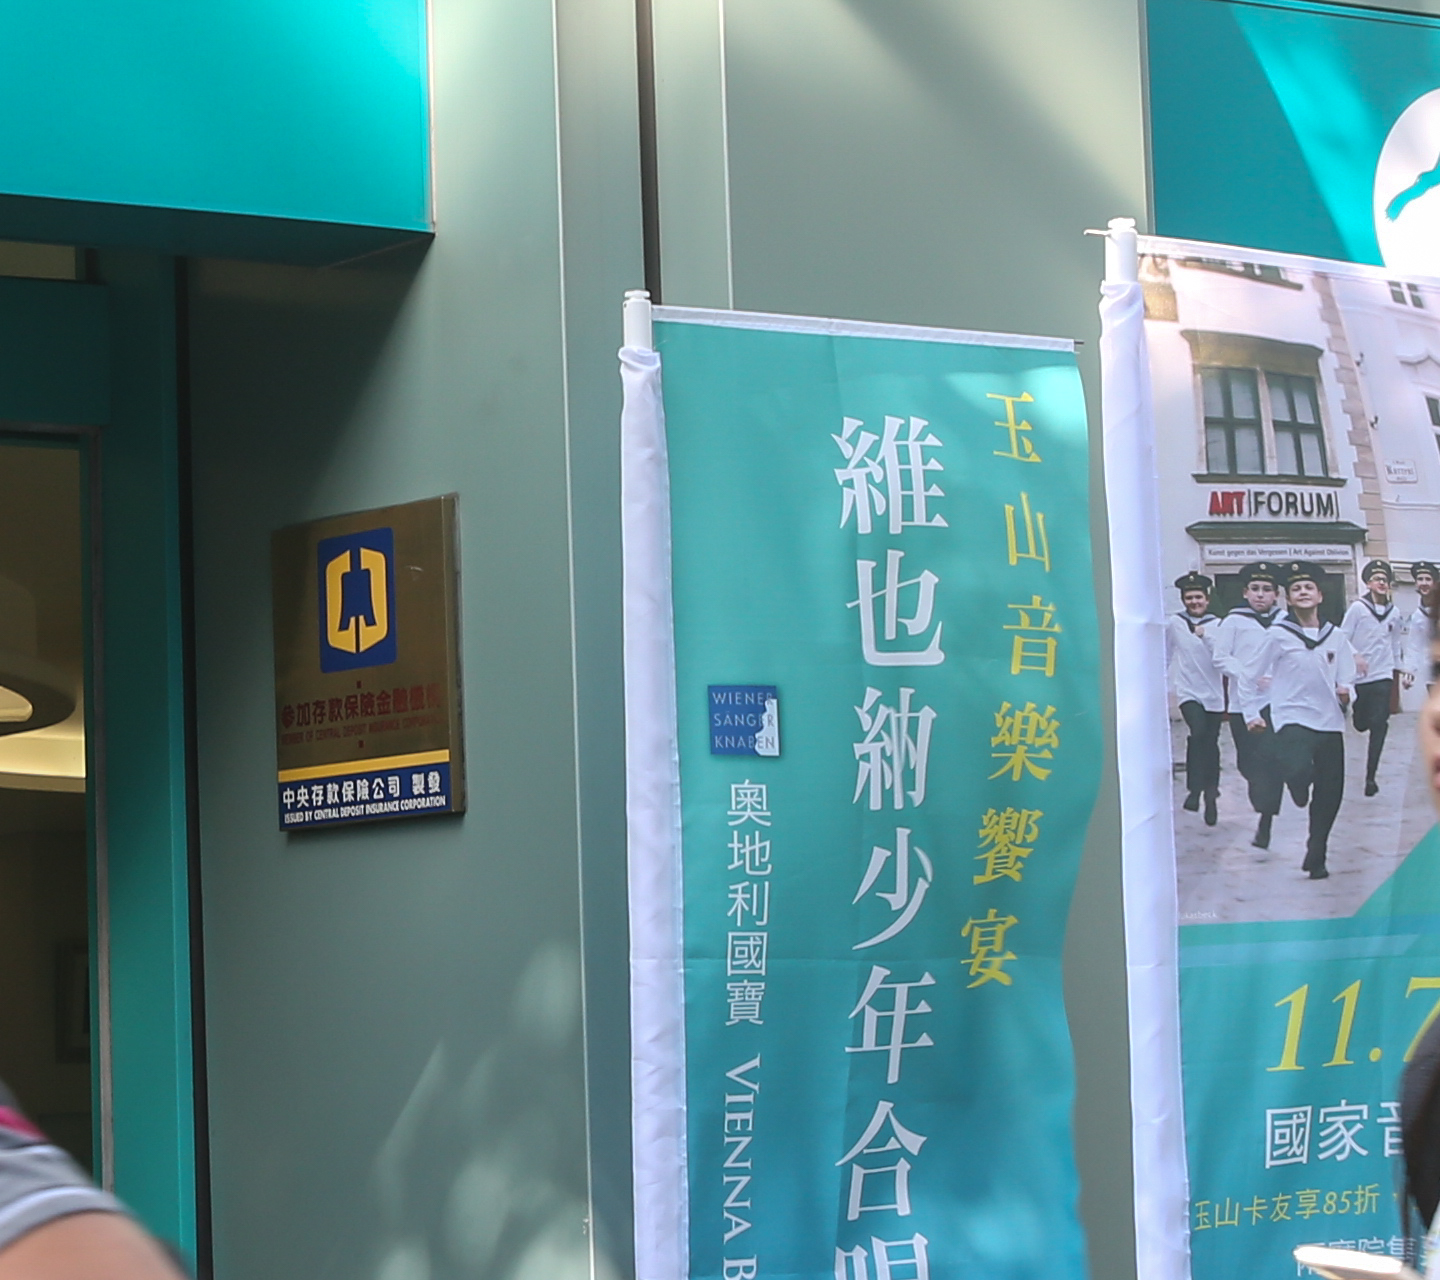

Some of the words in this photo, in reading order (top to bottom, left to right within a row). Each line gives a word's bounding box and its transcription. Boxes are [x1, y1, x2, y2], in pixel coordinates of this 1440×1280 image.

[712, 691, 774, 706] WIENER
[960, 391, 1062, 989] 玉山音樂饗宴
[714, 735, 776, 750] KNABEN
[282, 774, 401, 810] 中央存款保險公司
[314, 806, 340, 820] CENTRAL
[340, 802, 365, 817] DEPOSIT
[365, 799, 400, 815] INSURANCE
[400, 795, 446, 811] CORPORATION
[724, 778, 773, 1027] 奧地利國寶
[722, 1052, 761, 1245] VIENNA
